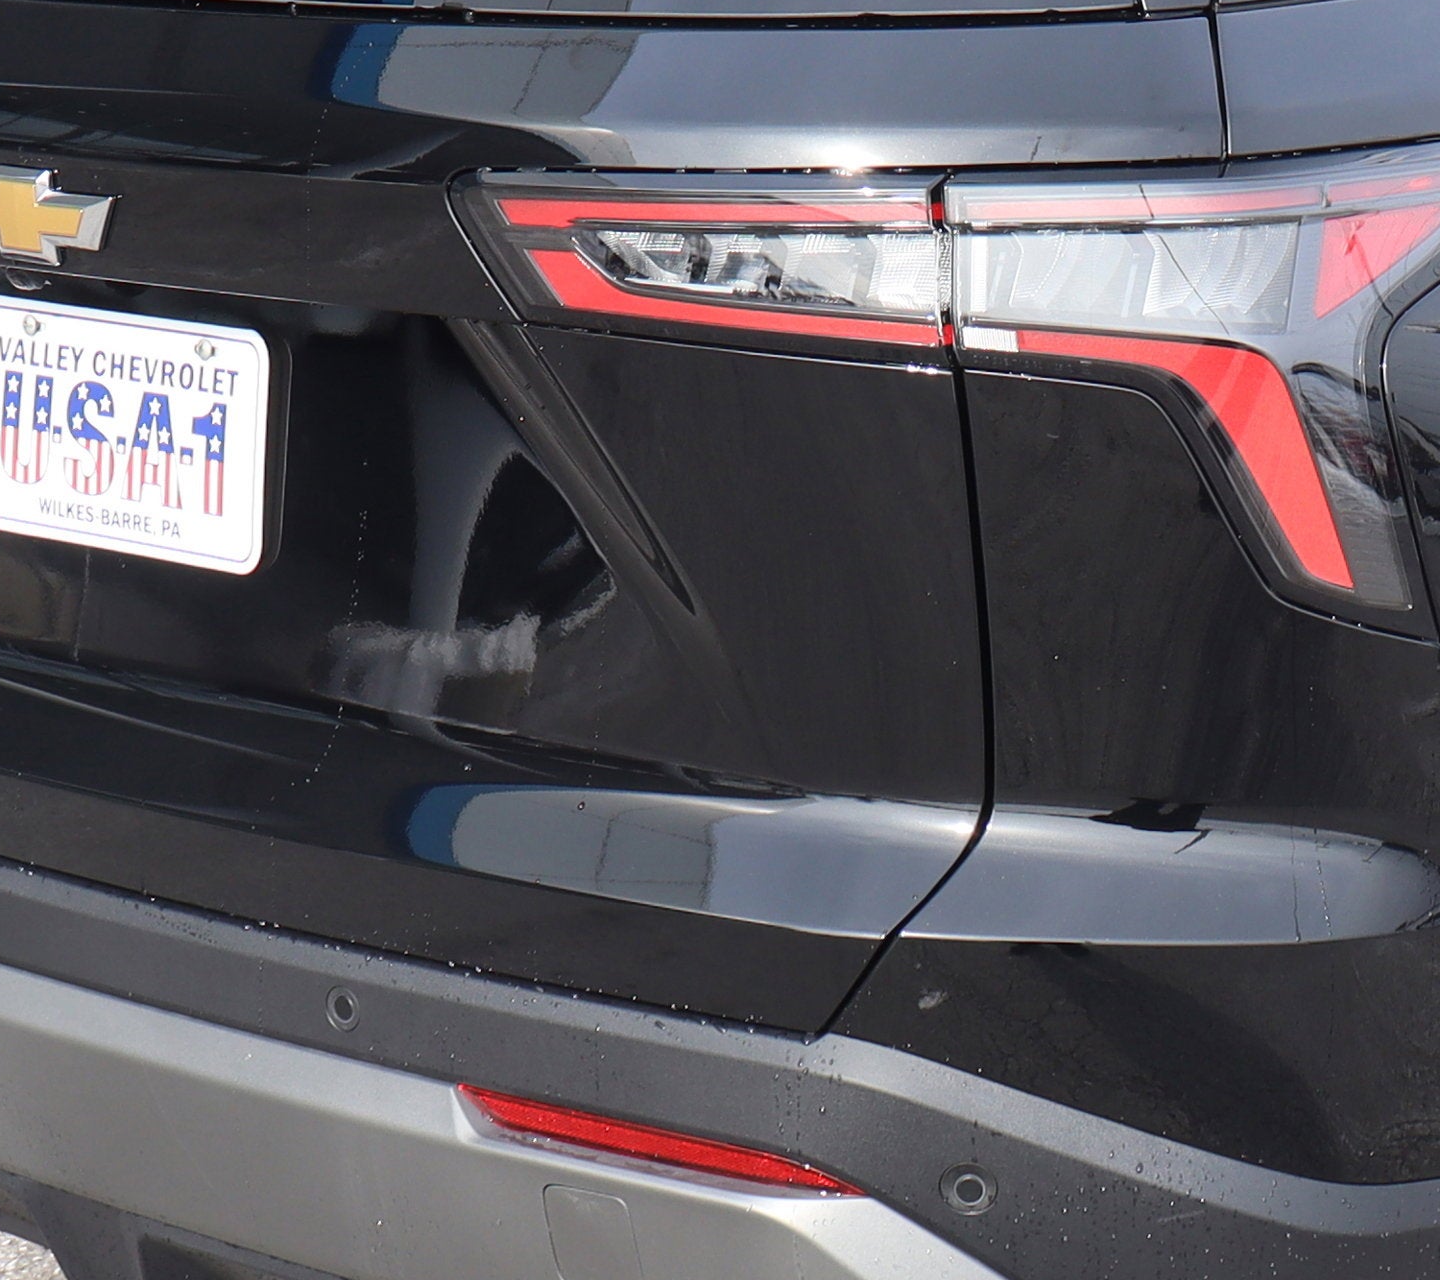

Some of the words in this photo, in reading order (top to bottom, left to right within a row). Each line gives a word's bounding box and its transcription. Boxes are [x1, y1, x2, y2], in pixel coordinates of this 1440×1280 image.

[92, 350, 239, 397] CHEVROLET
[39, 498, 158, 535] WILKES-BARRE,
[161, 517, 182, 539] PA
